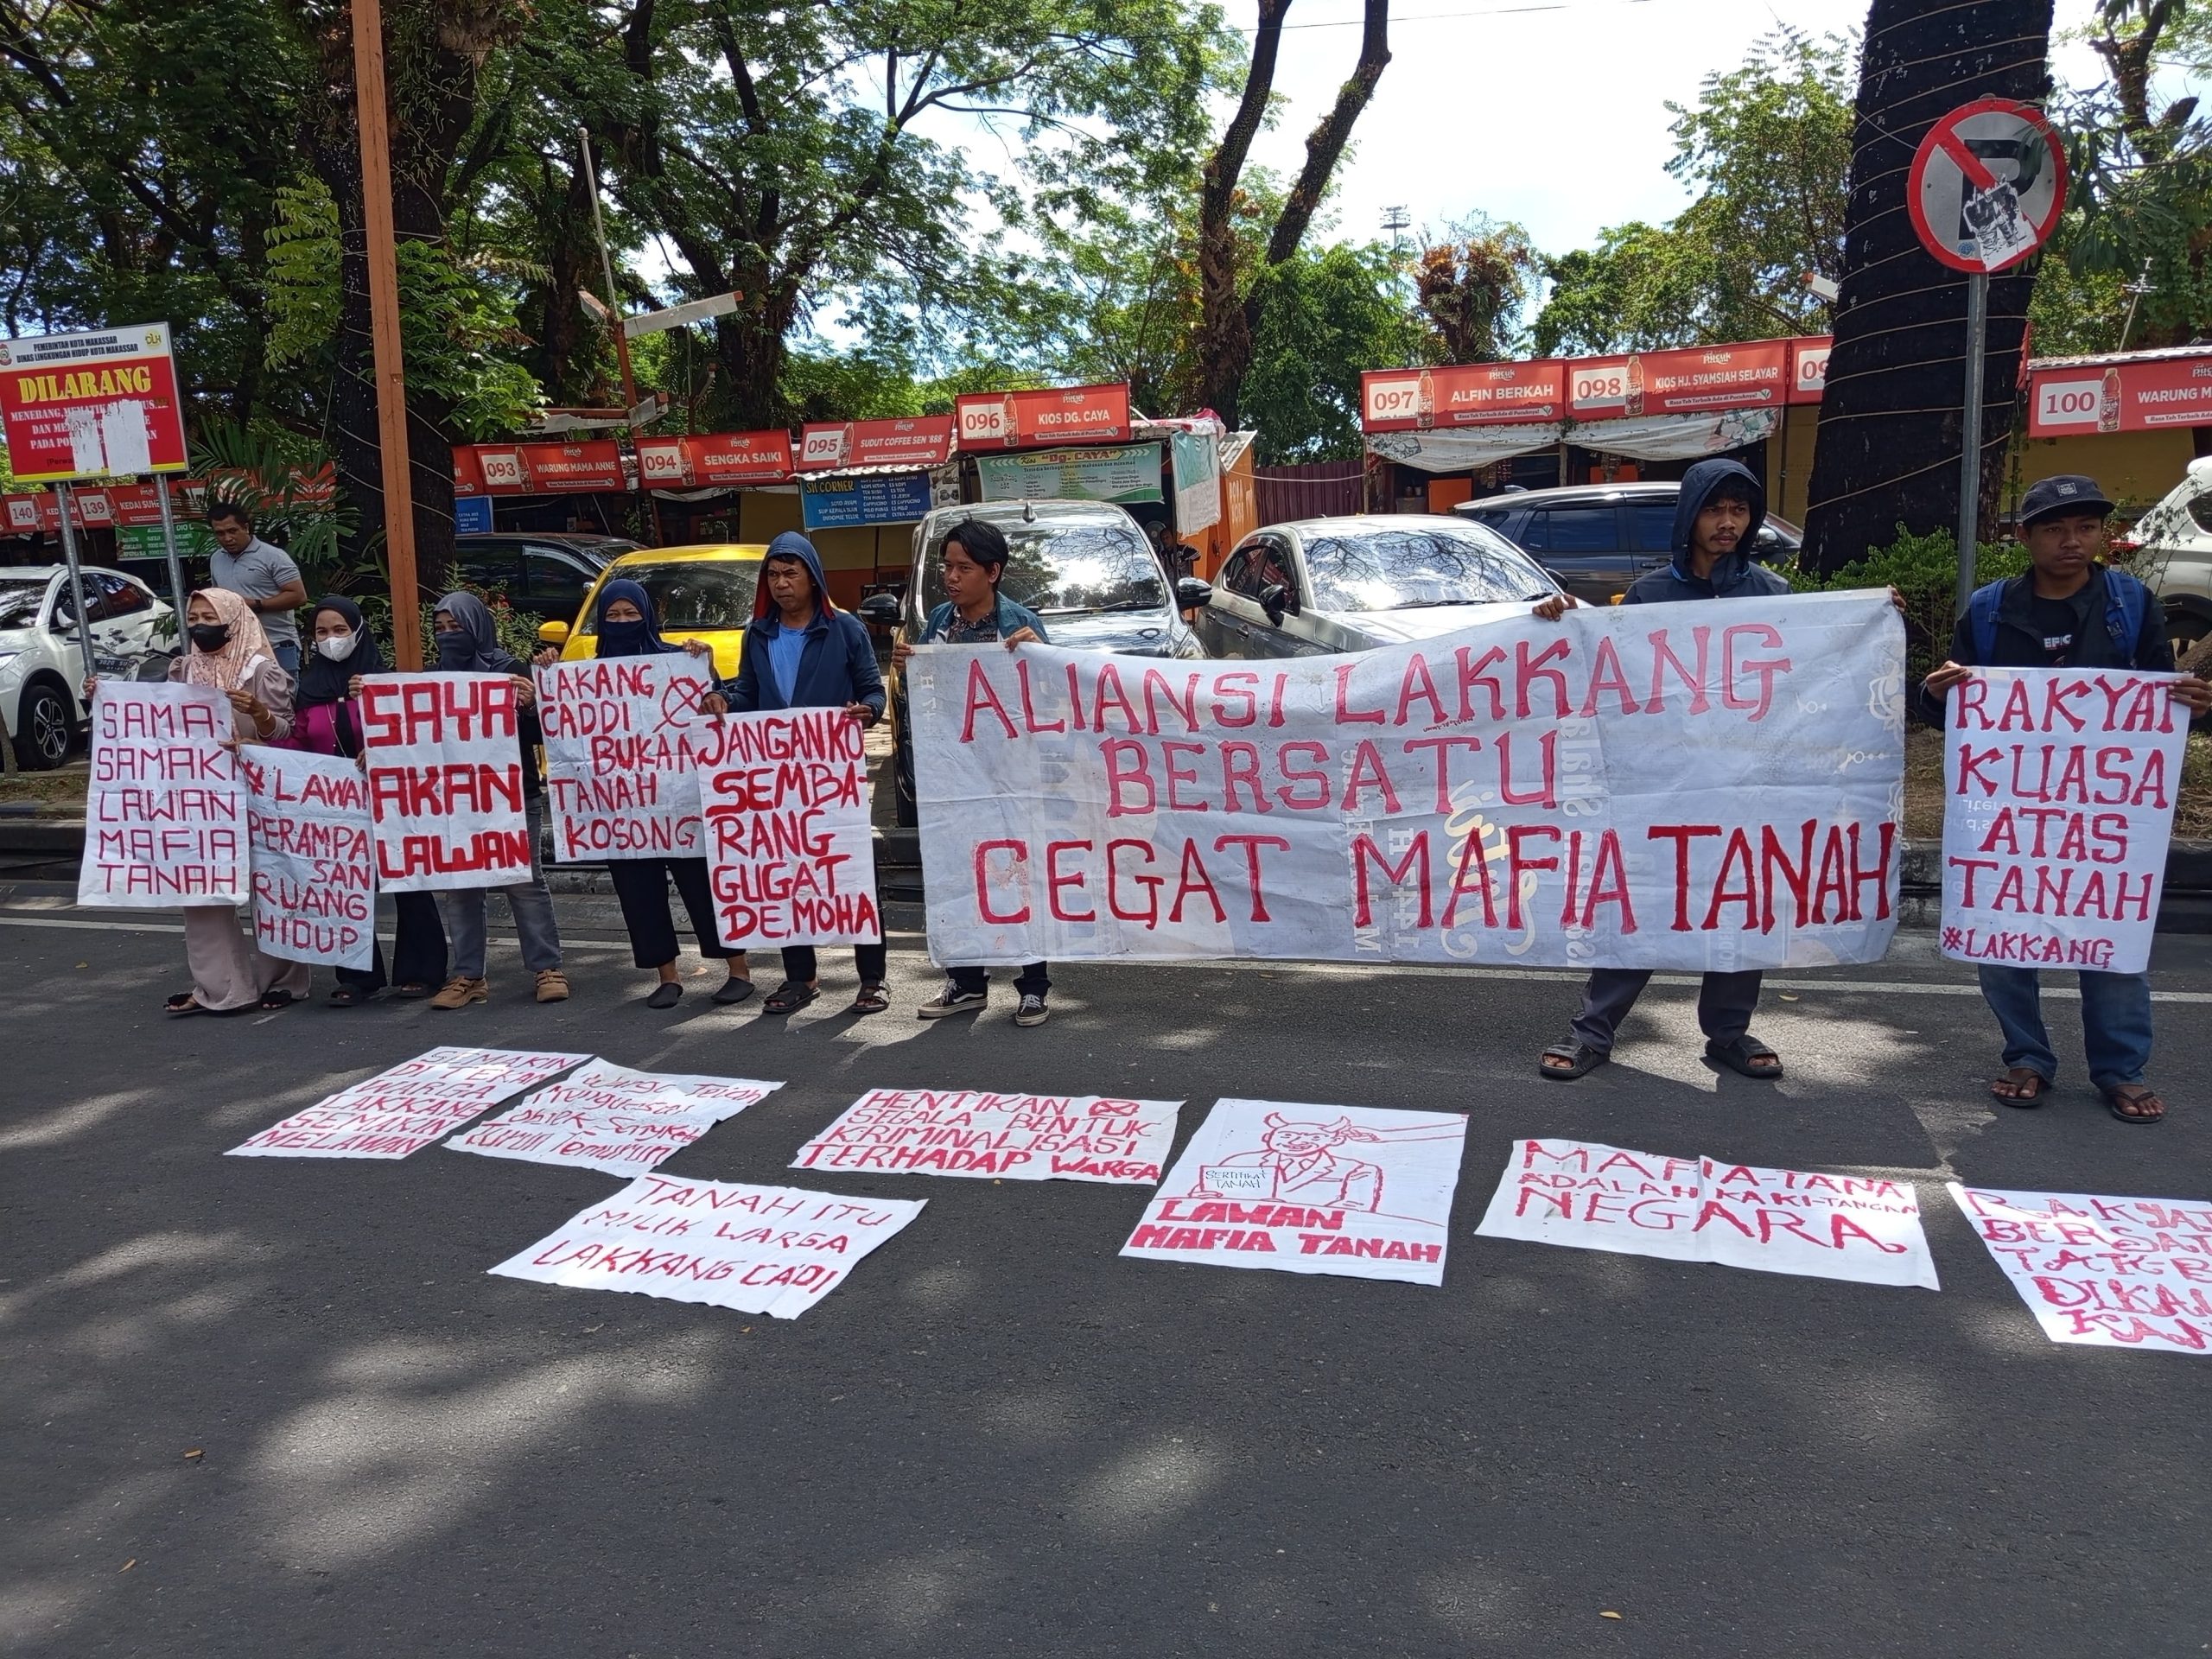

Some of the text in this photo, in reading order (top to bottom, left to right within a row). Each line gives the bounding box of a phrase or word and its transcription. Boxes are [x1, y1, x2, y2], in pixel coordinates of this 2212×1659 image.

[16, 344, 138, 363] DINAS LINGKUNGAN HIDUP KOTA MAKASSAR
[70, 339, 85, 347] KOTA
[86, 336, 118, 346] MAKASSAR
[17, 365, 151, 404] DILARANG
[1655, 366, 1778, 390] KIOS HJ. SYAMSIAH SELAYAR
[1802, 360, 1829, 379] 09
[1374, 391, 1414, 410] 097
[1451, 384, 1554, 404] ALFIN BERKAH
[1577, 377, 1621, 399] 098
[2046, 391, 2095, 415] 100
[2137, 389, 2197, 404] WARUNG
[32, 423, 51, 435] DAN
[965, 412, 1000, 430] 096
[1038, 409, 1110, 425] KIOS DG. CAYA
[30, 439, 59, 449] PADA
[704, 451, 782, 466] SENGKA SAIKI
[807, 438, 838, 454] 095
[860, 438, 884, 448] SUDUT
[884, 436, 912, 447] COFFEE
[912, 435, 927, 443] SEN
[486, 461, 616, 478] 093 WARUNG MAMA ANNE
[645, 454, 677, 471] 094
[820, 480, 854, 493] CORNER
[12, 507, 33, 519] 140
[85, 502, 105, 515] 139
[119, 501, 142, 510] KEDAI
[537, 663, 655, 702] LAKANG
[960, 622, 1794, 744] ALIANSI LAKKANG
[363, 680, 518, 747] SAYA
[542, 700, 631, 740] CADDI
[1955, 675, 2175, 734] RAKYAT
[697, 709, 865, 767] JANGANKO
[97, 747, 236, 782] SAMAKI
[591, 733, 698, 777] BUKAN
[1099, 730, 1558, 818] BERSATU
[1955, 743, 2169, 810] KUASA
[99, 789, 236, 822] LAWAN
[369, 764, 523, 824] AKAN
[550, 772, 658, 813] TANAH
[99, 830, 237, 862] MAFIA
[247, 809, 371, 862] PERAMPA
[564, 815, 703, 859] KOSONG
[710, 809, 837, 863] RANG
[1977, 807, 2129, 864] ATAS
[376, 830, 531, 879] LAWAN
[97, 864, 237, 895] TANAH
[310, 859, 371, 891] SAN
[712, 854, 853, 904] GUGAT
[973, 833, 1291, 931] CEGAT
[1351, 823, 1638, 937] MAFIA
[1647, 818, 1897, 937] TANAH
[1948, 855, 2154, 922] TANAH
[251, 871, 368, 921] RUANG
[257, 909, 359, 954] HIDUP
[1942, 926, 2115, 970] #LAKKANG
[356, 1077, 496, 1100] WARGA
[862, 1090, 1071, 1116] HENTIKAN
[281, 1110, 456, 1135] SEMAKIN
[327, 1094, 501, 1121] LAKKANG
[847, 1109, 1162, 1137] SEGALA BENTUK
[244, 1129, 433, 1155] MELAWAN
[823, 1125, 1138, 1156] KRIMINALISASI
[802, 1142, 1160, 1180] TERHADAP WARGA
[1211, 1179, 1261, 1189] TANAH
[1517, 1172, 1699, 1198] ADALAH
[634, 1176, 893, 1227] TANAH ITU
[1155, 1199, 1346, 1231] LAWAN
[582, 1209, 849, 1255] MILIK WARGA
[1515, 1186, 1908, 1254] NEGARA
[1129, 1224, 1443, 1263] MAFIA TANAH
[1982, 1219, 2212, 1255] BERSAT
[532, 1238, 838, 1294] LAKKANG CADI
